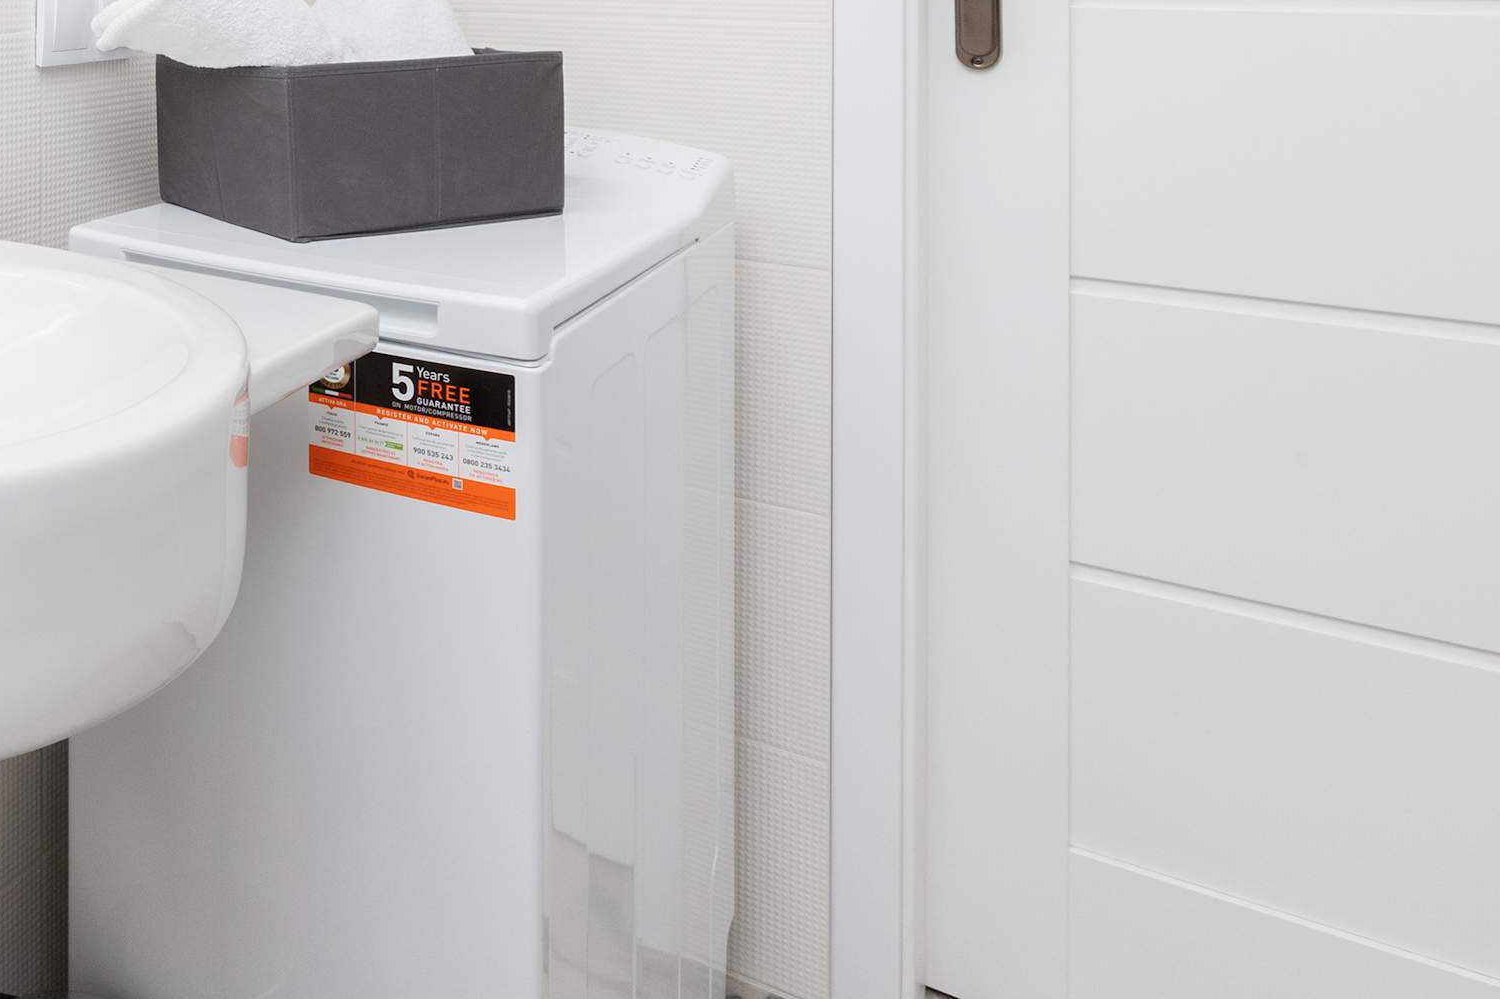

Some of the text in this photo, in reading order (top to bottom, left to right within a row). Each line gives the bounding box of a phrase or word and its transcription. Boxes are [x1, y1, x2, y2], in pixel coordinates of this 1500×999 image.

[391, 362, 450, 402] 5 Years
[417, 379, 471, 405] FREE
[403, 403, 473, 422] MOTOR/COMPRESSOR
[416, 397, 472, 414] GUARANTEE
[376, 408, 489, 435] REGISTER AND ACTIVATE NOW
[413, 446, 426, 456] 900
[441, 452, 454, 461] 243
[462, 457, 480, 467] 0800
